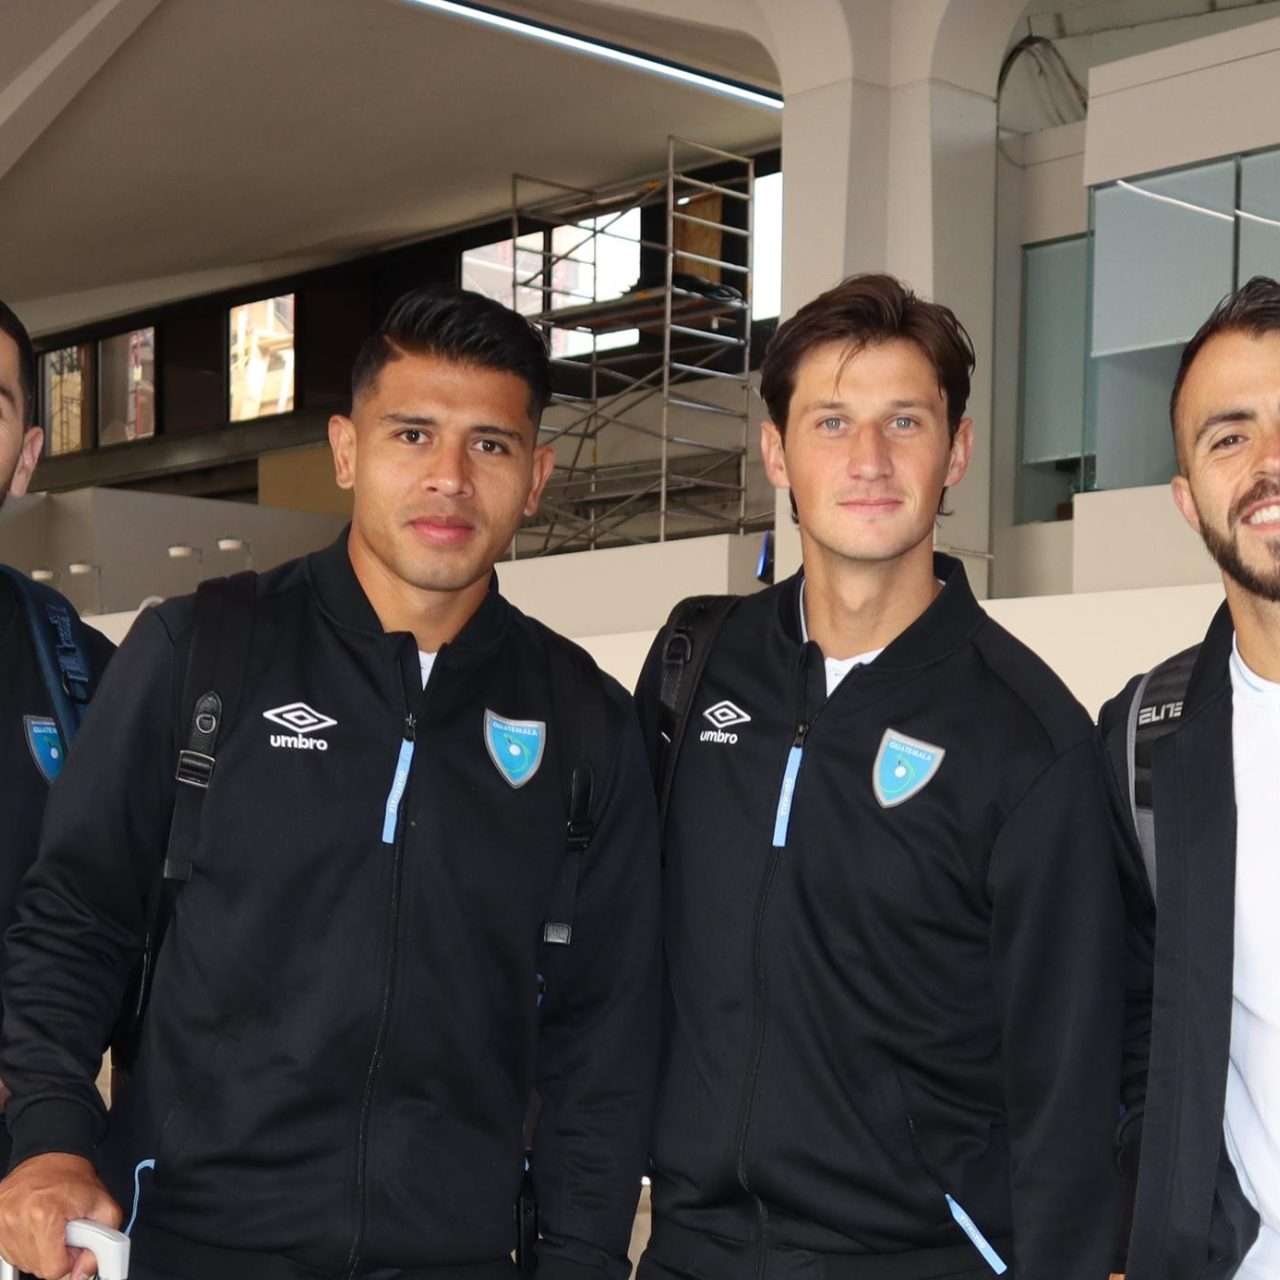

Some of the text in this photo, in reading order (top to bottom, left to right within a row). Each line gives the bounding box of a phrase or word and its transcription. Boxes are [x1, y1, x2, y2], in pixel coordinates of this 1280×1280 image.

[1138, 701, 1184, 725] ELITE
[269, 732, 329, 751] umbro
[699, 729, 738, 745] umbro
